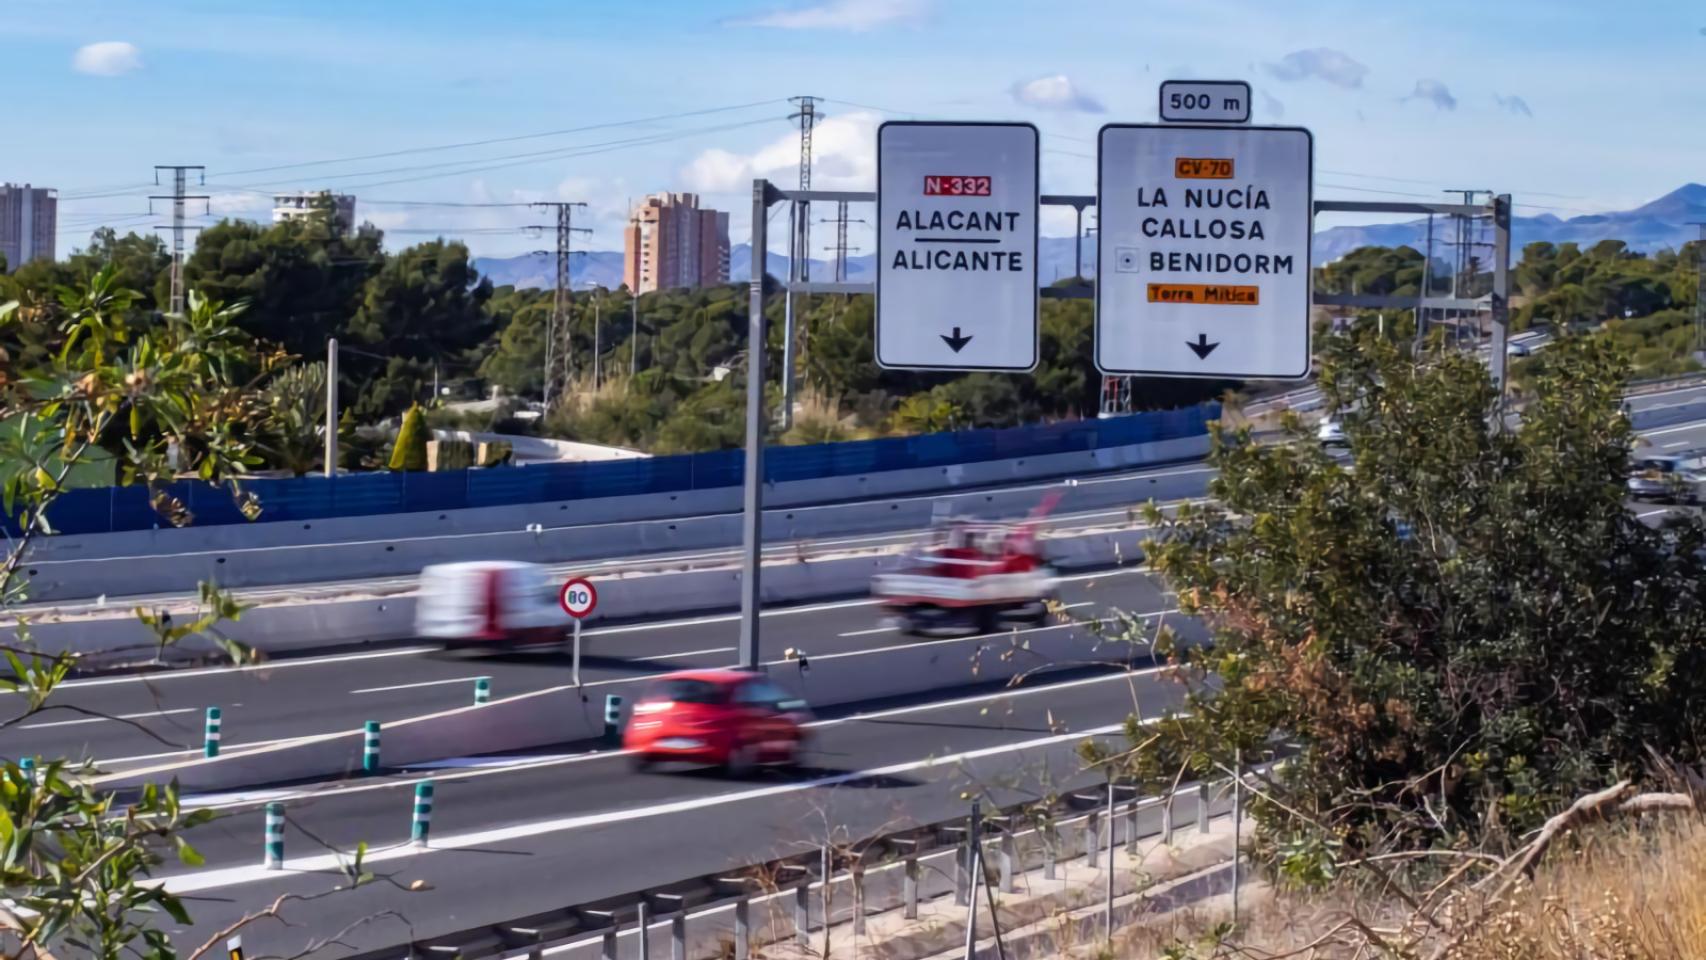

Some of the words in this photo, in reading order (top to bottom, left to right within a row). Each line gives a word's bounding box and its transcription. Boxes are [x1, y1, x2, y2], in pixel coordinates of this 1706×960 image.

[1170, 93, 1211, 110] 500
[1223, 98, 1240, 110] m
[1178, 161, 1231, 176] CV-70
[926, 177, 989, 194] N-332
[1137, 187, 1168, 208] LA
[1184, 185, 1271, 210] NUCÍA
[896, 210, 1020, 232] ALACANT
[1141, 217, 1265, 240] CALLOSA
[892, 250, 1023, 271] ALICANTE
[1150, 252, 1293, 275] BENIDORM
[1151, 286, 1194, 301] Terra
[568, 590, 588, 605] 80
